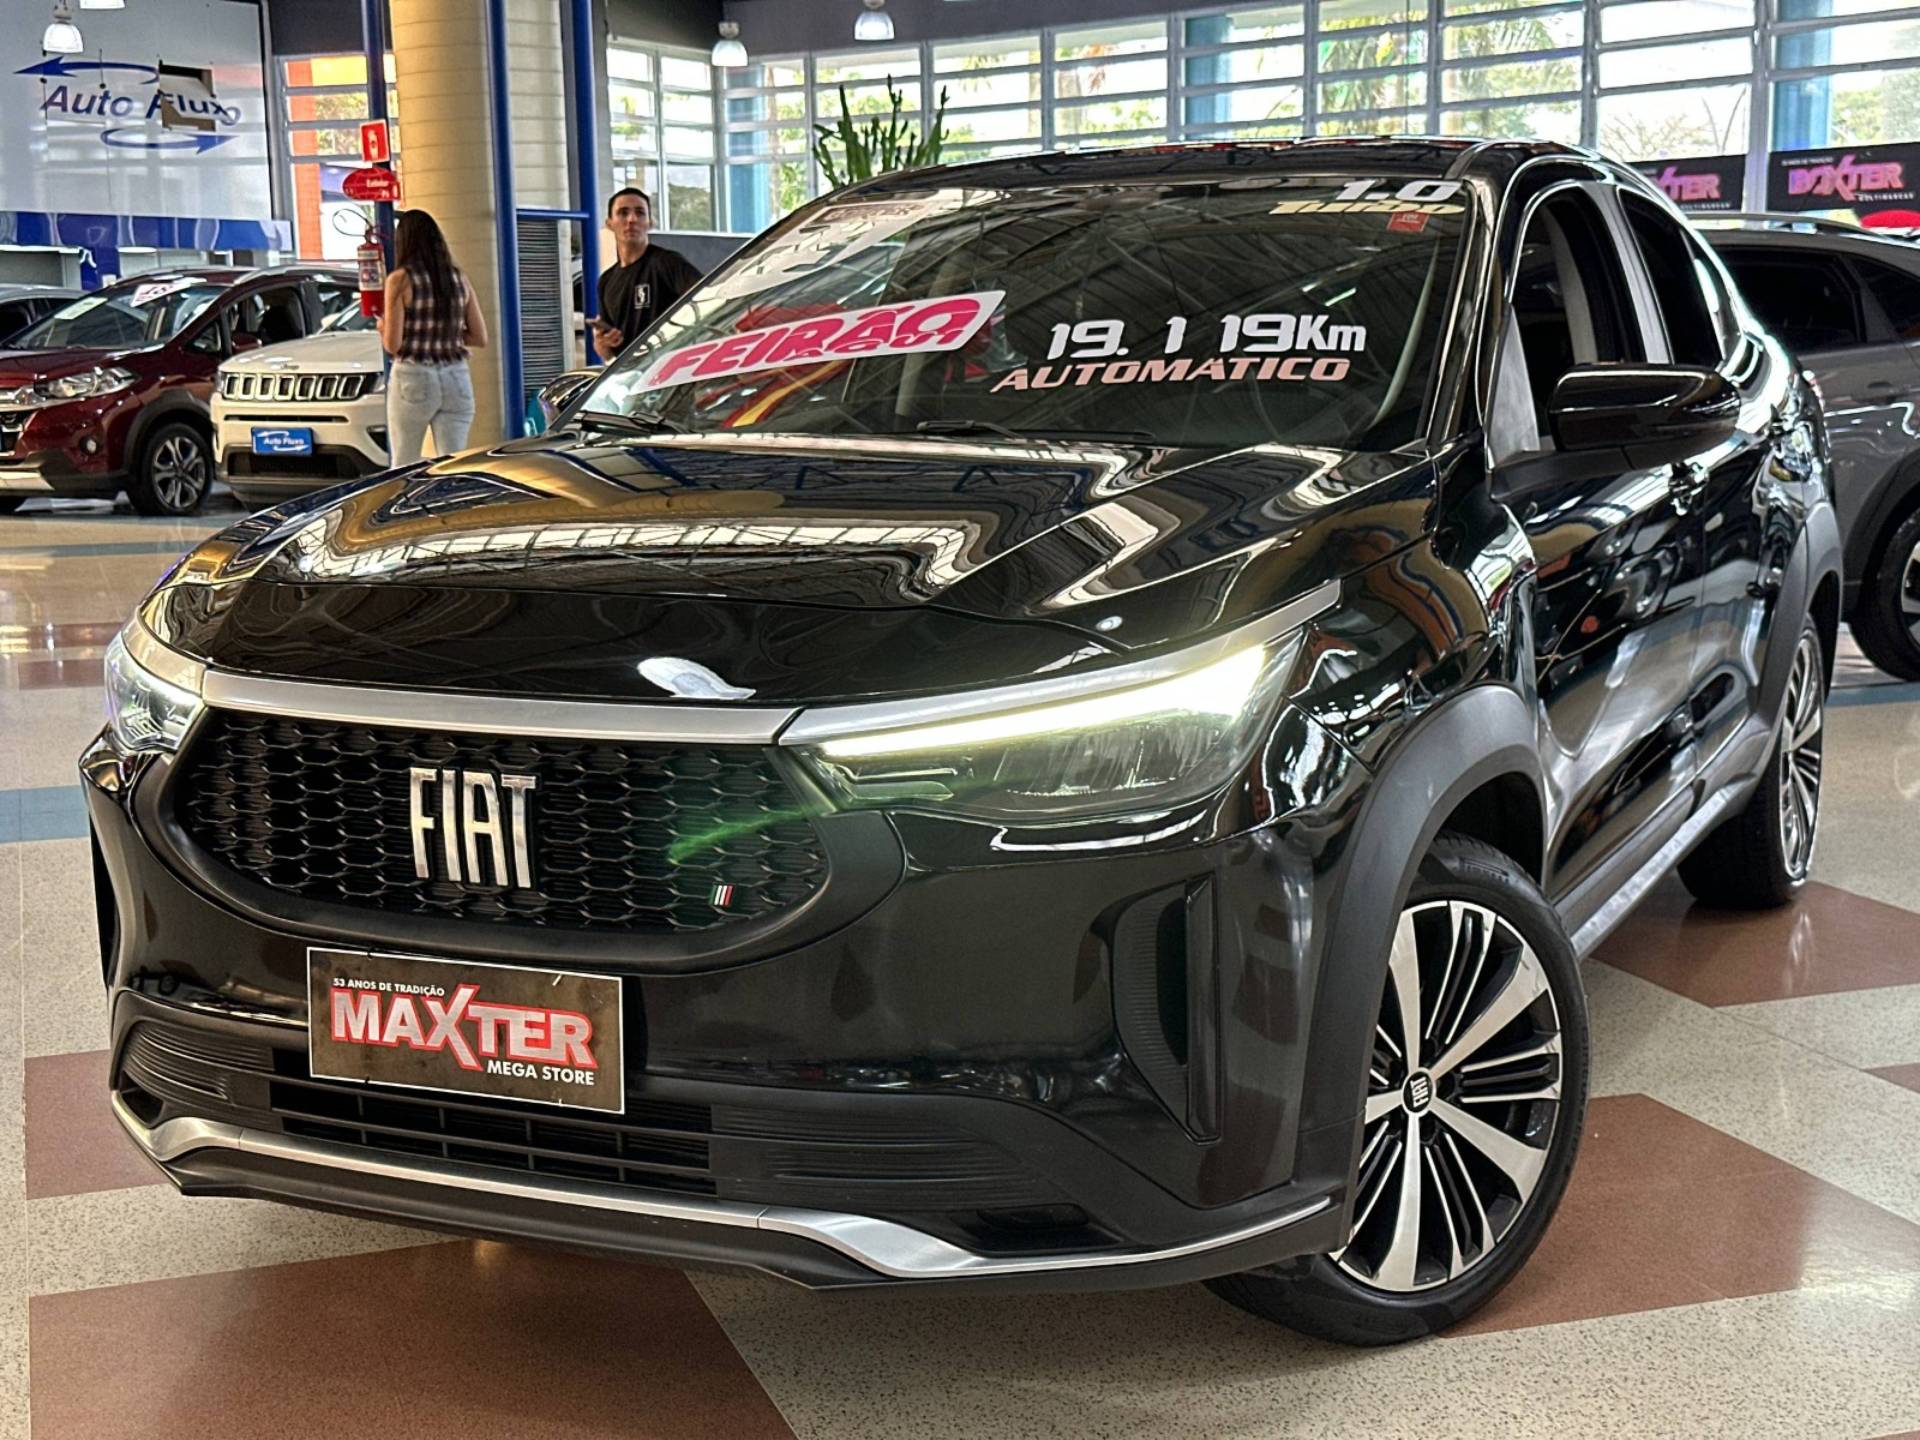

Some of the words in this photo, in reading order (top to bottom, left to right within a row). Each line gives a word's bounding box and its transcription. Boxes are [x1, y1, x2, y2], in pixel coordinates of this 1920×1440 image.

[40, 85, 133, 117] Auto
[145, 89, 241, 126] Fluxo
[1335, 179, 1464, 202] 1.0
[409, 767, 537, 889] FIAT
[332, 977, 345, 988] 53
[347, 979, 377, 991] ANOS
[378, 982, 393, 993] DE
[394, 983, 446, 998] TRADIÇÃO
[331, 983, 598, 1072] MAXTER
[486, 1059, 539, 1080] MEGA
[541, 1065, 595, 1087] STORE
